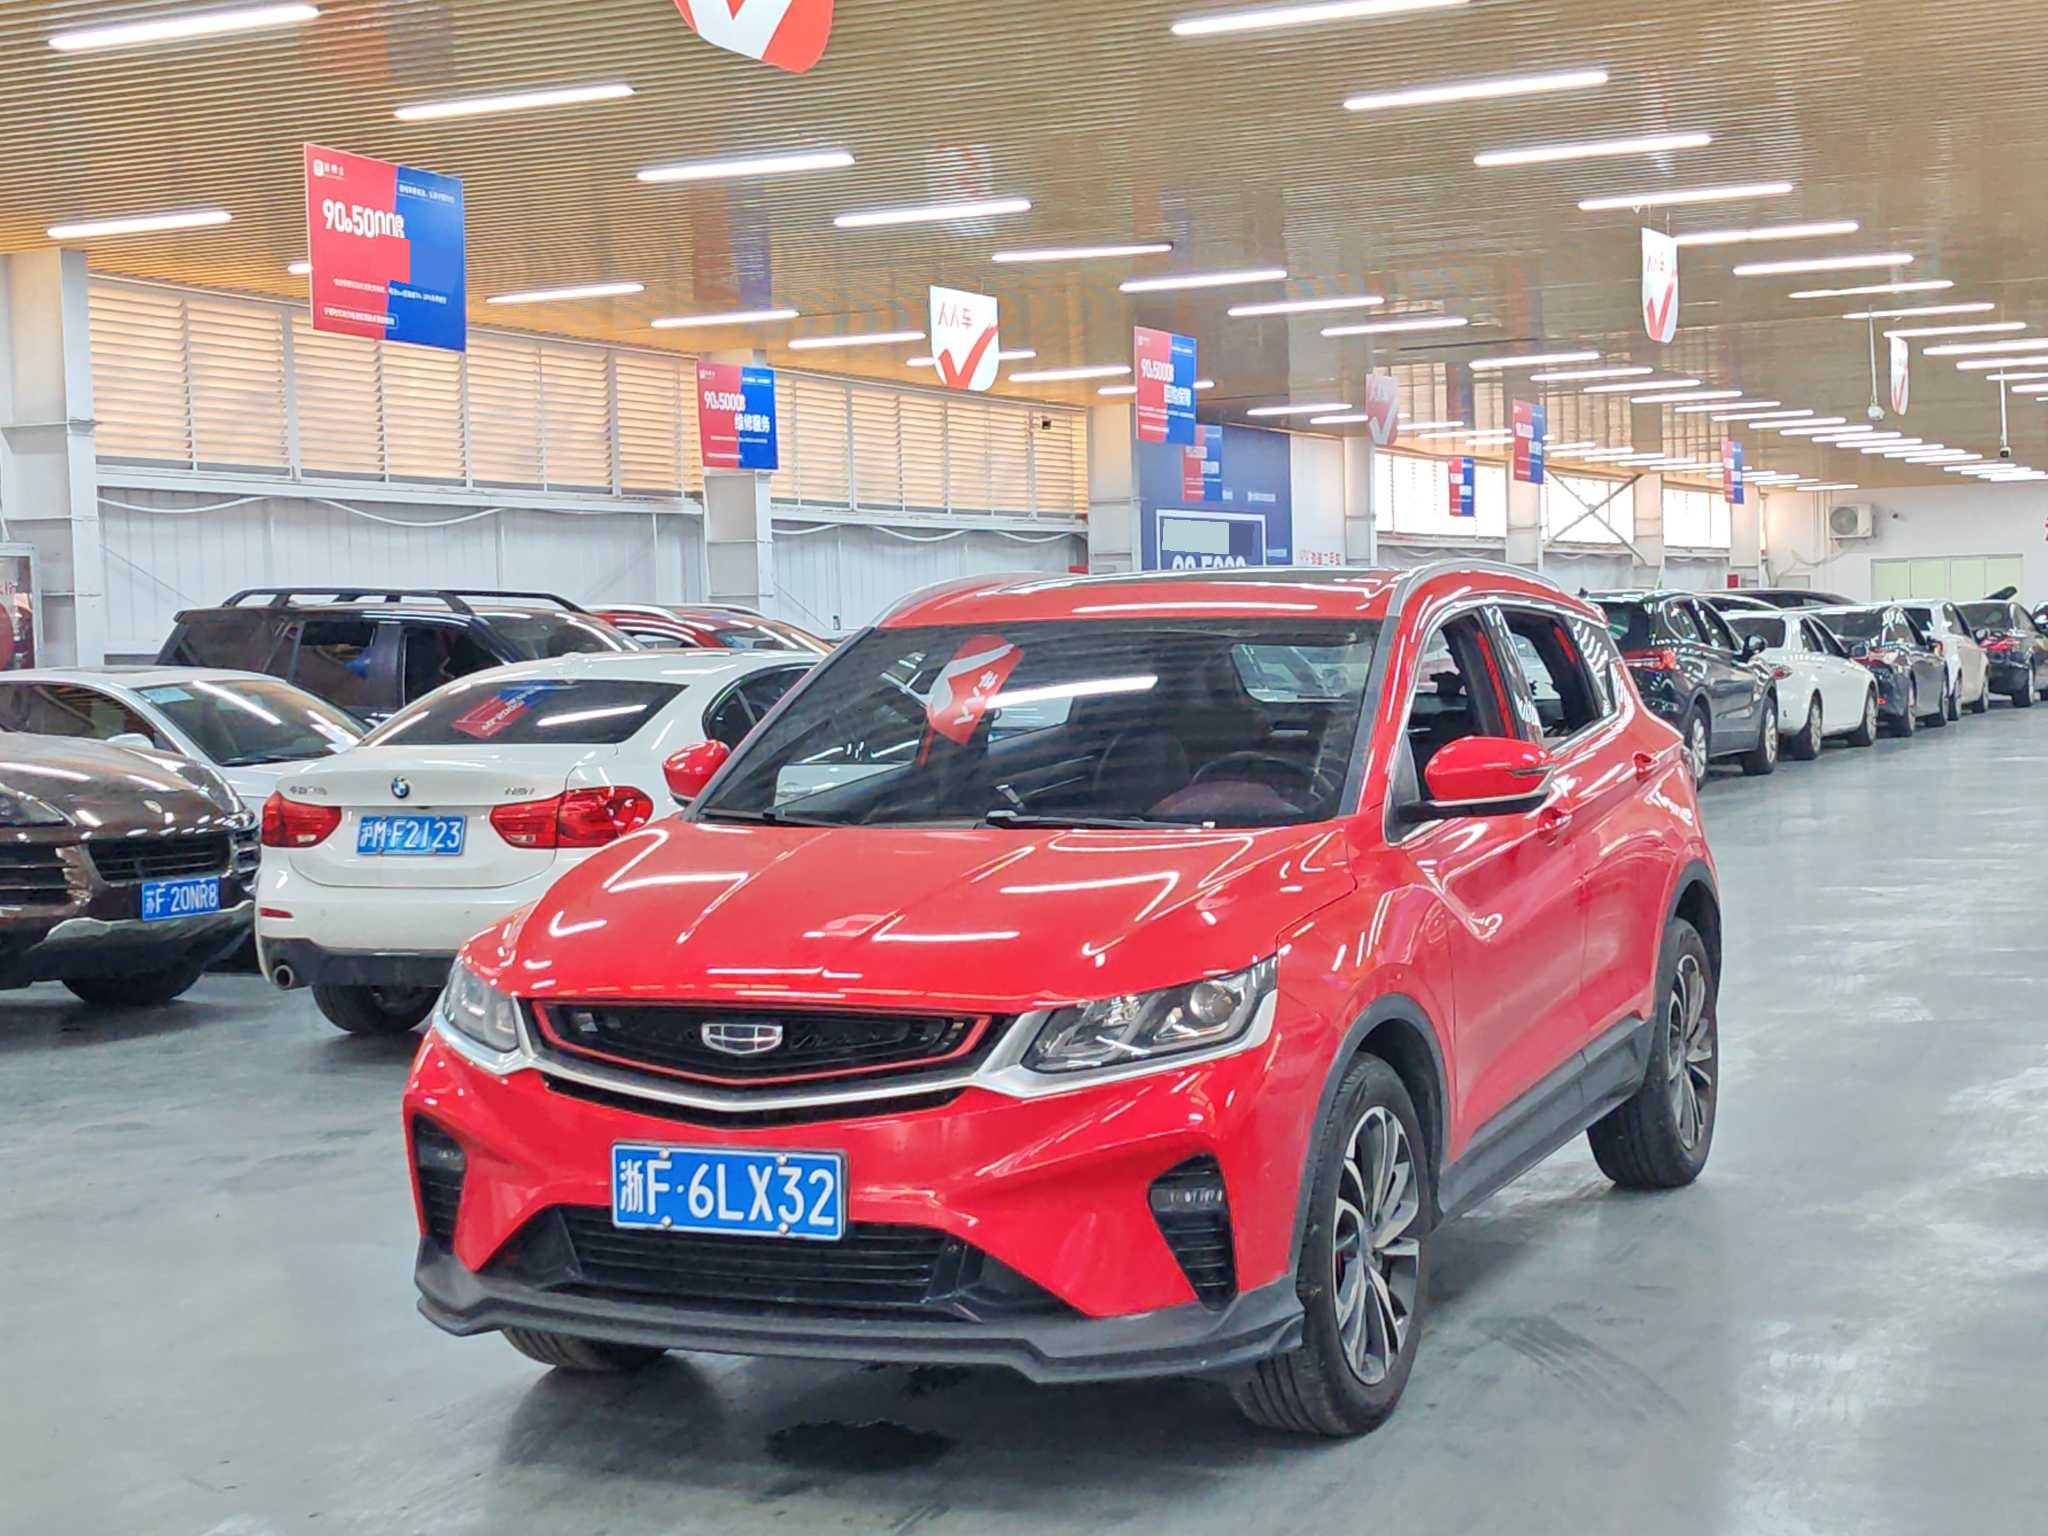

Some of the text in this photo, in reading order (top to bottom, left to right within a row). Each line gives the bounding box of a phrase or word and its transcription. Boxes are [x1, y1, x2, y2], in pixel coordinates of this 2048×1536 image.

[938, 302, 972, 329] 人人车
[359, 819, 461, 849] 沪M·F2123
[619, 1158, 836, 1226] 浙F·6LX32
